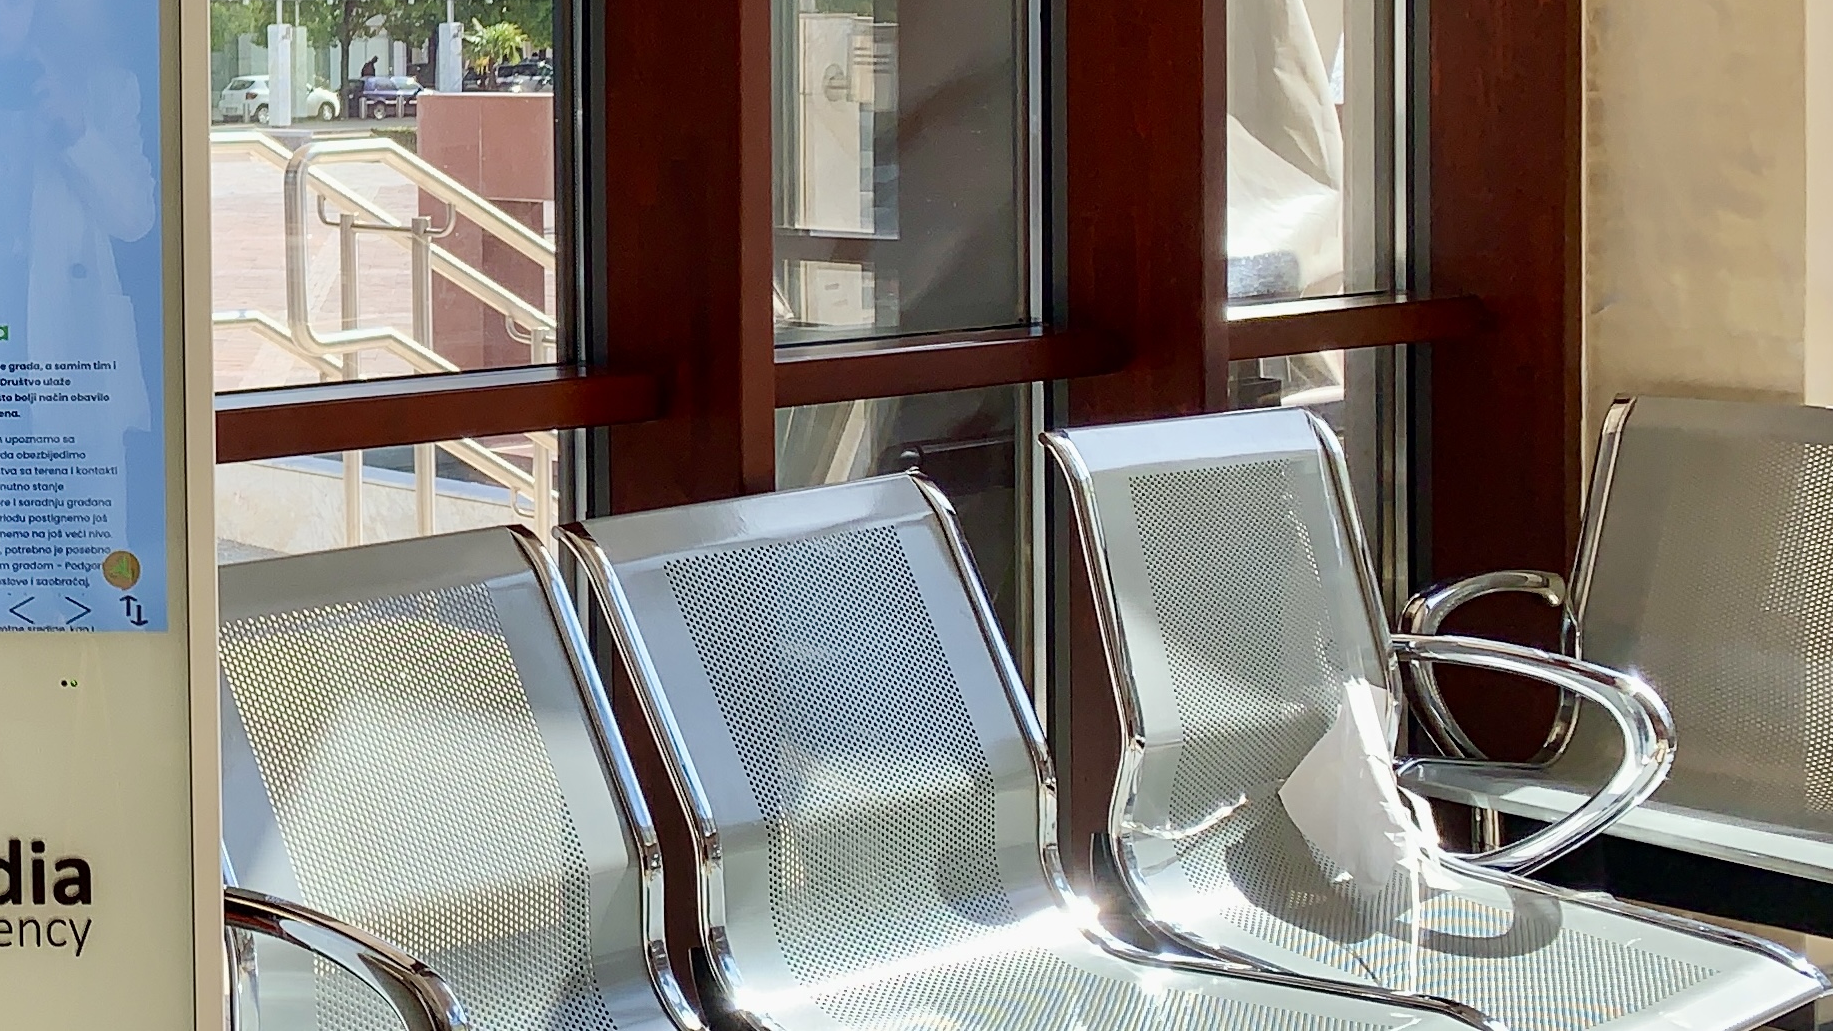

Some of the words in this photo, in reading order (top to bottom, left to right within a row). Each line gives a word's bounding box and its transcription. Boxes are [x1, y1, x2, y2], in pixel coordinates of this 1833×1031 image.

[55, 361, 91, 370] samim
[93, 361, 111, 370] tim
[0, 377, 41, 386] Društvo
[43, 377, 71, 386] ulaže
[15, 393, 37, 404] bolji
[39, 393, 69, 402] način
[71, 393, 110, 402] obavilo
[5, 436, 60, 445] upoznamo
[32, 482, 64, 493] stanje
